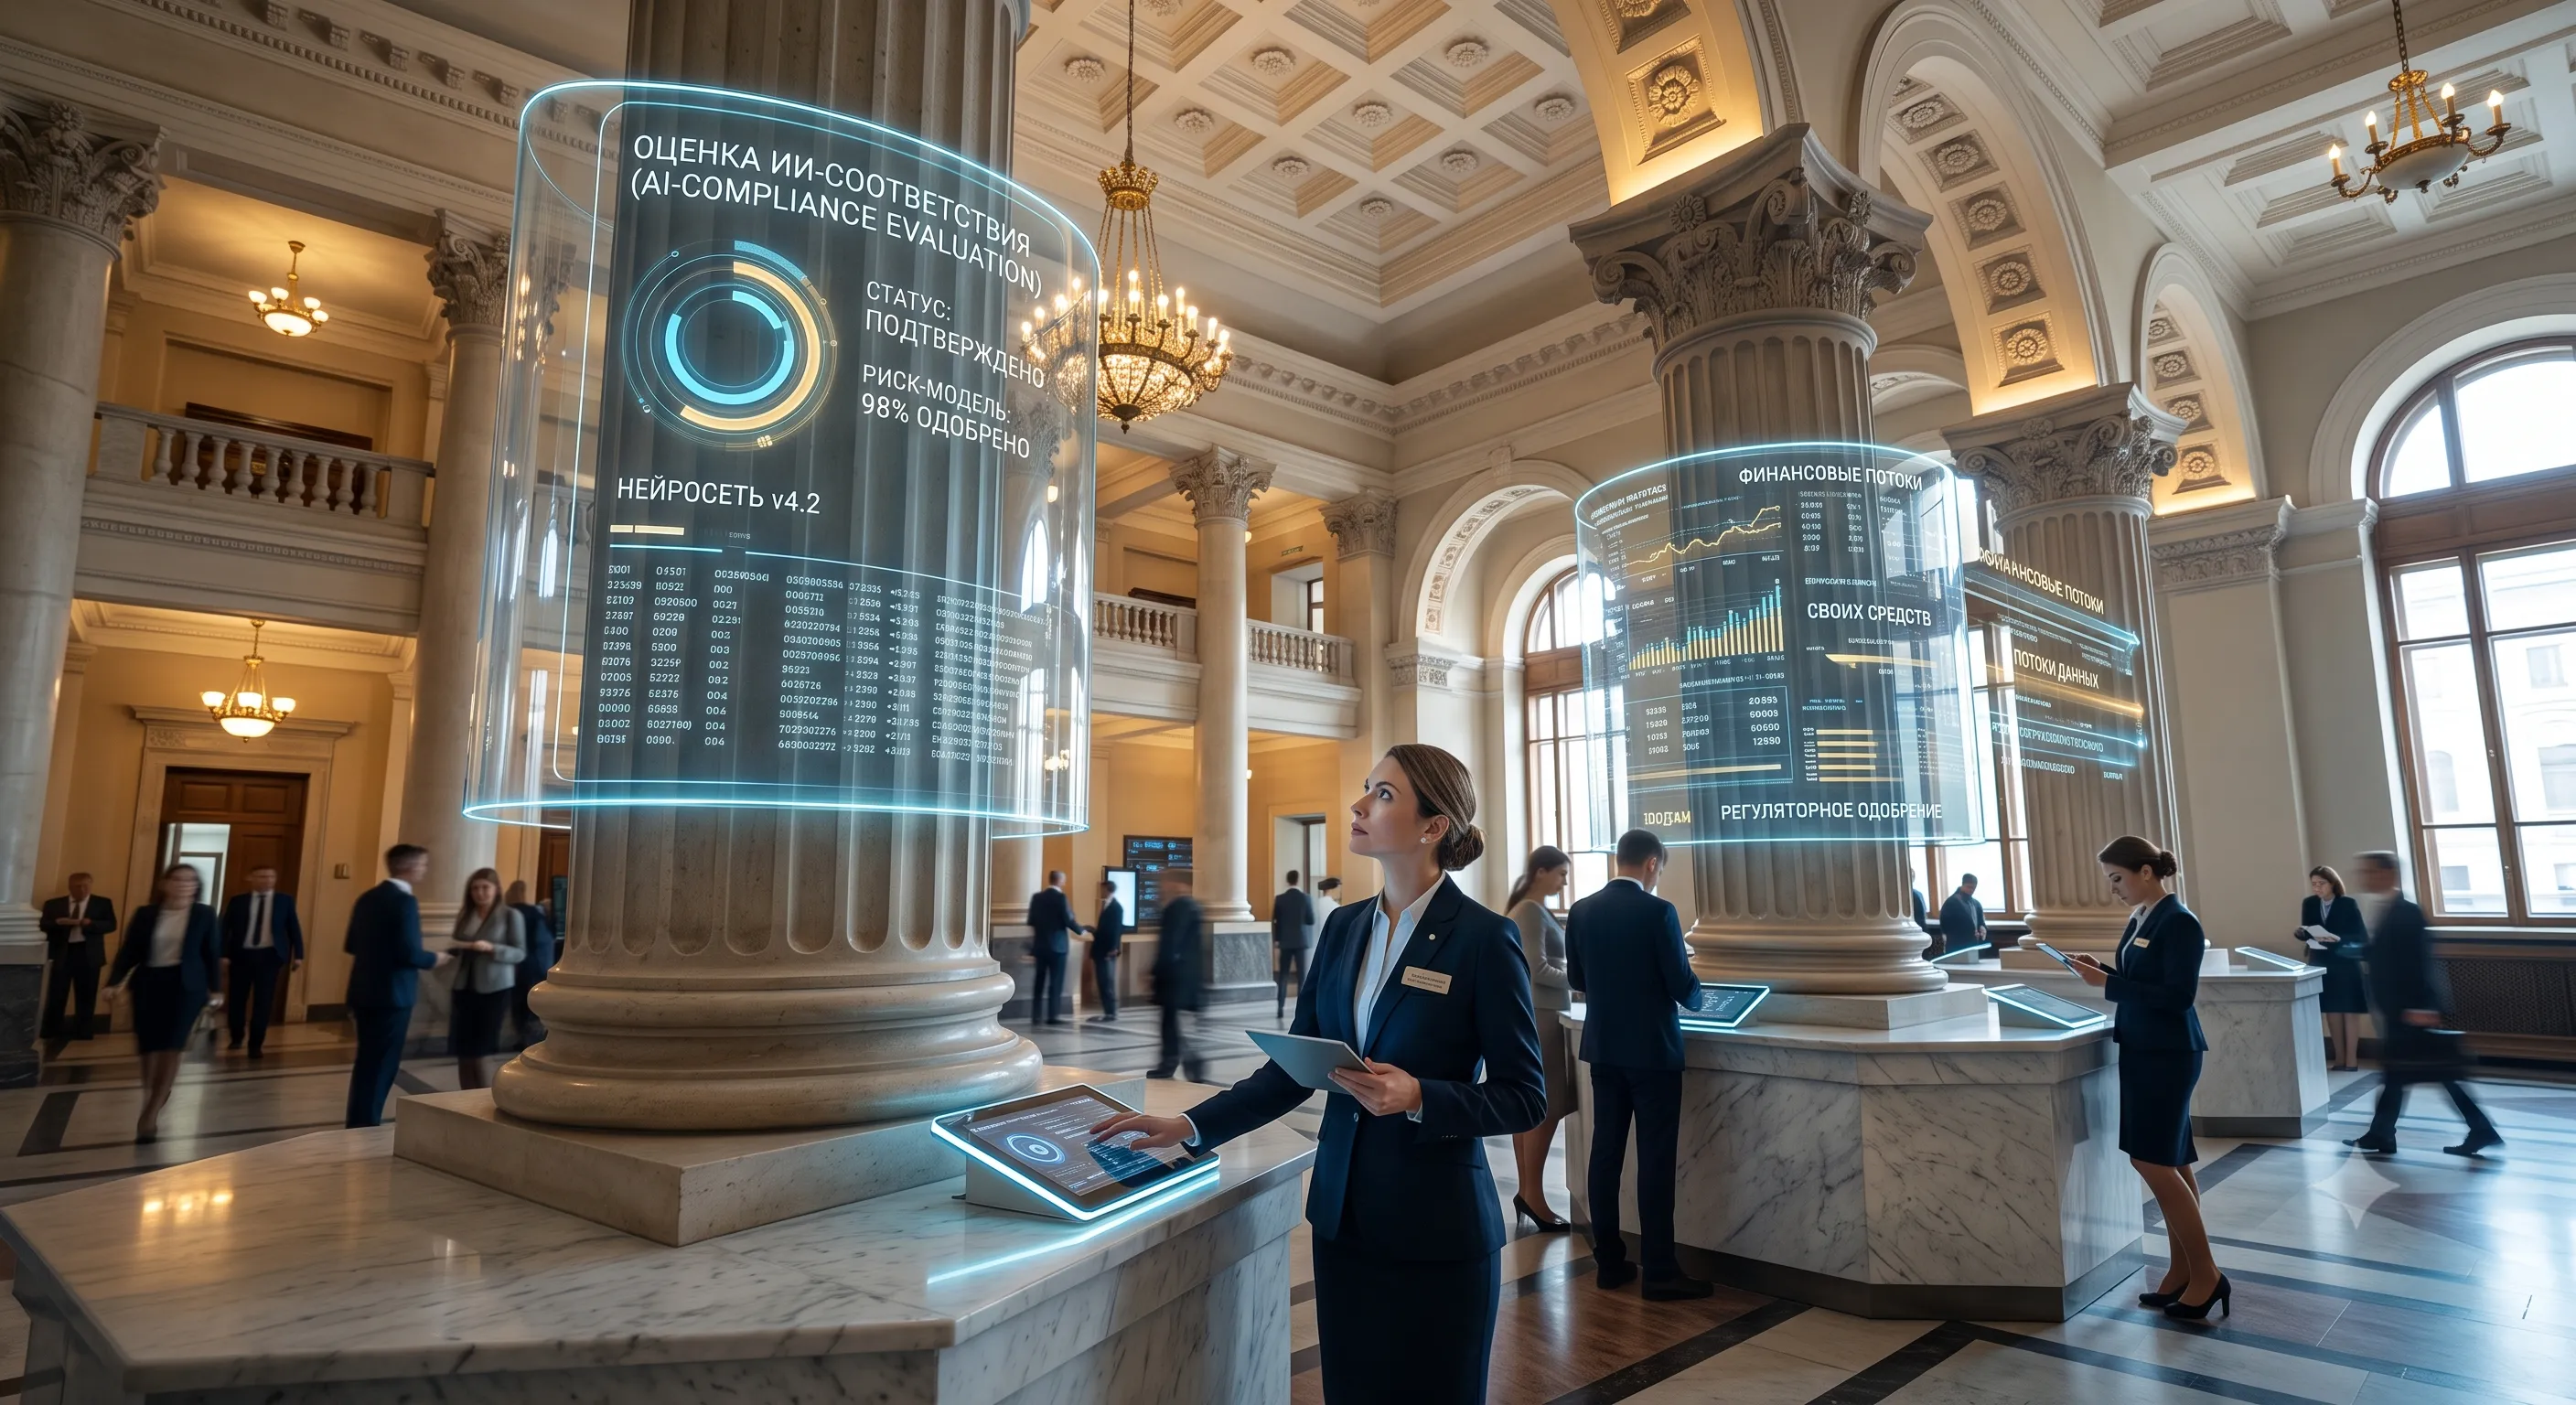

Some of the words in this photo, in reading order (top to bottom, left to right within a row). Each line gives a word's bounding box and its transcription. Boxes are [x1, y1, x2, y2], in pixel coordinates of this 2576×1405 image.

[634, 134, 761, 172] ОЦЕНКА
[772, 148, 1031, 258] ИИ-СООТВЕТСТВИЯ
[631, 167, 879, 231] (AI-COMPLIANCE
[886, 210, 1043, 298] EVALUATION)
[866, 280, 951, 321] СТАТУС:
[865, 309, 1045, 389] ПОДТВЕРЖДЕНО
[863, 364, 1011, 424] РИСК-МОДЕЛЬ:
[861, 393, 909, 423] 98%
[916, 404, 1031, 460] ОДОБРЕНО
[617, 477, 764, 509] НЕЙРОСЕТЬ
[772, 492, 821, 515] v4.2
[1738, 465, 1862, 486] ФИНАНСОВЫЕ
[1866, 468, 1923, 491] ПОТОКИ
[1808, 603, 1863, 619] СВОИХ
[1868, 605, 1931, 627] СРЕДСТВ
[2066, 585, 2104, 615] ПОТОКИ
[2014, 649, 2056, 676] ПОТОКИ
[2057, 663, 2099, 689] ДАННЫХ
[1721, 801, 1854, 820] РЕГУЛЯТОРНОЕ
[1858, 802, 1942, 821] ОДОБРЕНИЕ
